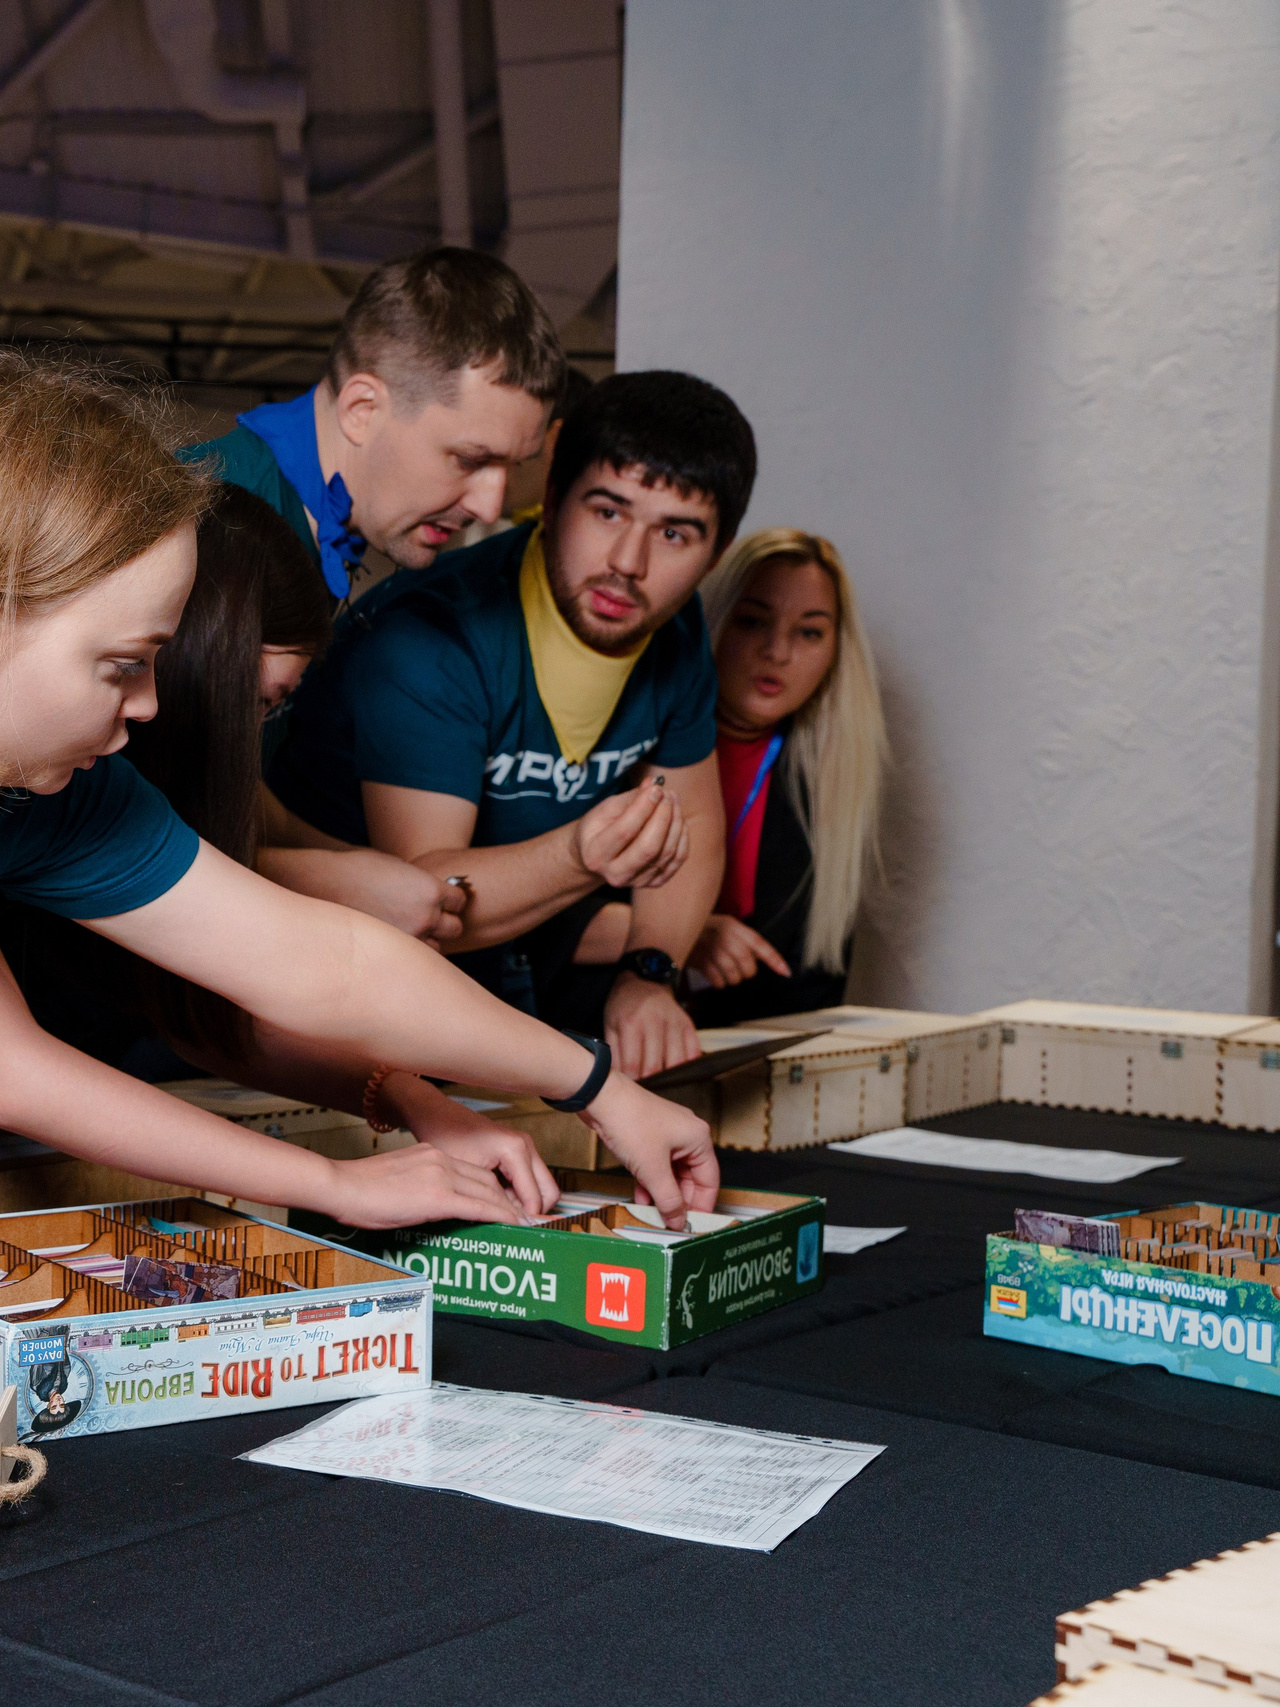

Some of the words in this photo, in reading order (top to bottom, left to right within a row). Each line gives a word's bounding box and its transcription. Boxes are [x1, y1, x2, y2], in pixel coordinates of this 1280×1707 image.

[395, 1230, 545, 1263] WWW.RIGHTGAMES.RU
[708, 1246, 793, 1303] ЭВОЛЮЦИЯ
[1101, 1268, 1134, 1290] ИГРА
[450, 1295, 498, 1312] Дмитрия
[1135, 1272, 1228, 1307] НАСТОЛЬНАЯ
[500, 1304, 526, 1318] Игра
[1060, 1283, 1274, 1365] ПОСЕЛЕНЦЫ
[21, 1338, 63, 1352] WONDER
[219, 1336, 252, 1357] Муна
[267, 1329, 306, 1348] Алана
[22, 1351, 36, 1363] OF
[281, 1353, 307, 1382] TO
[312, 1333, 419, 1382] TICKET
[105, 1371, 195, 1405] ЕВРОПА
[201, 1357, 273, 1400] RIDE
